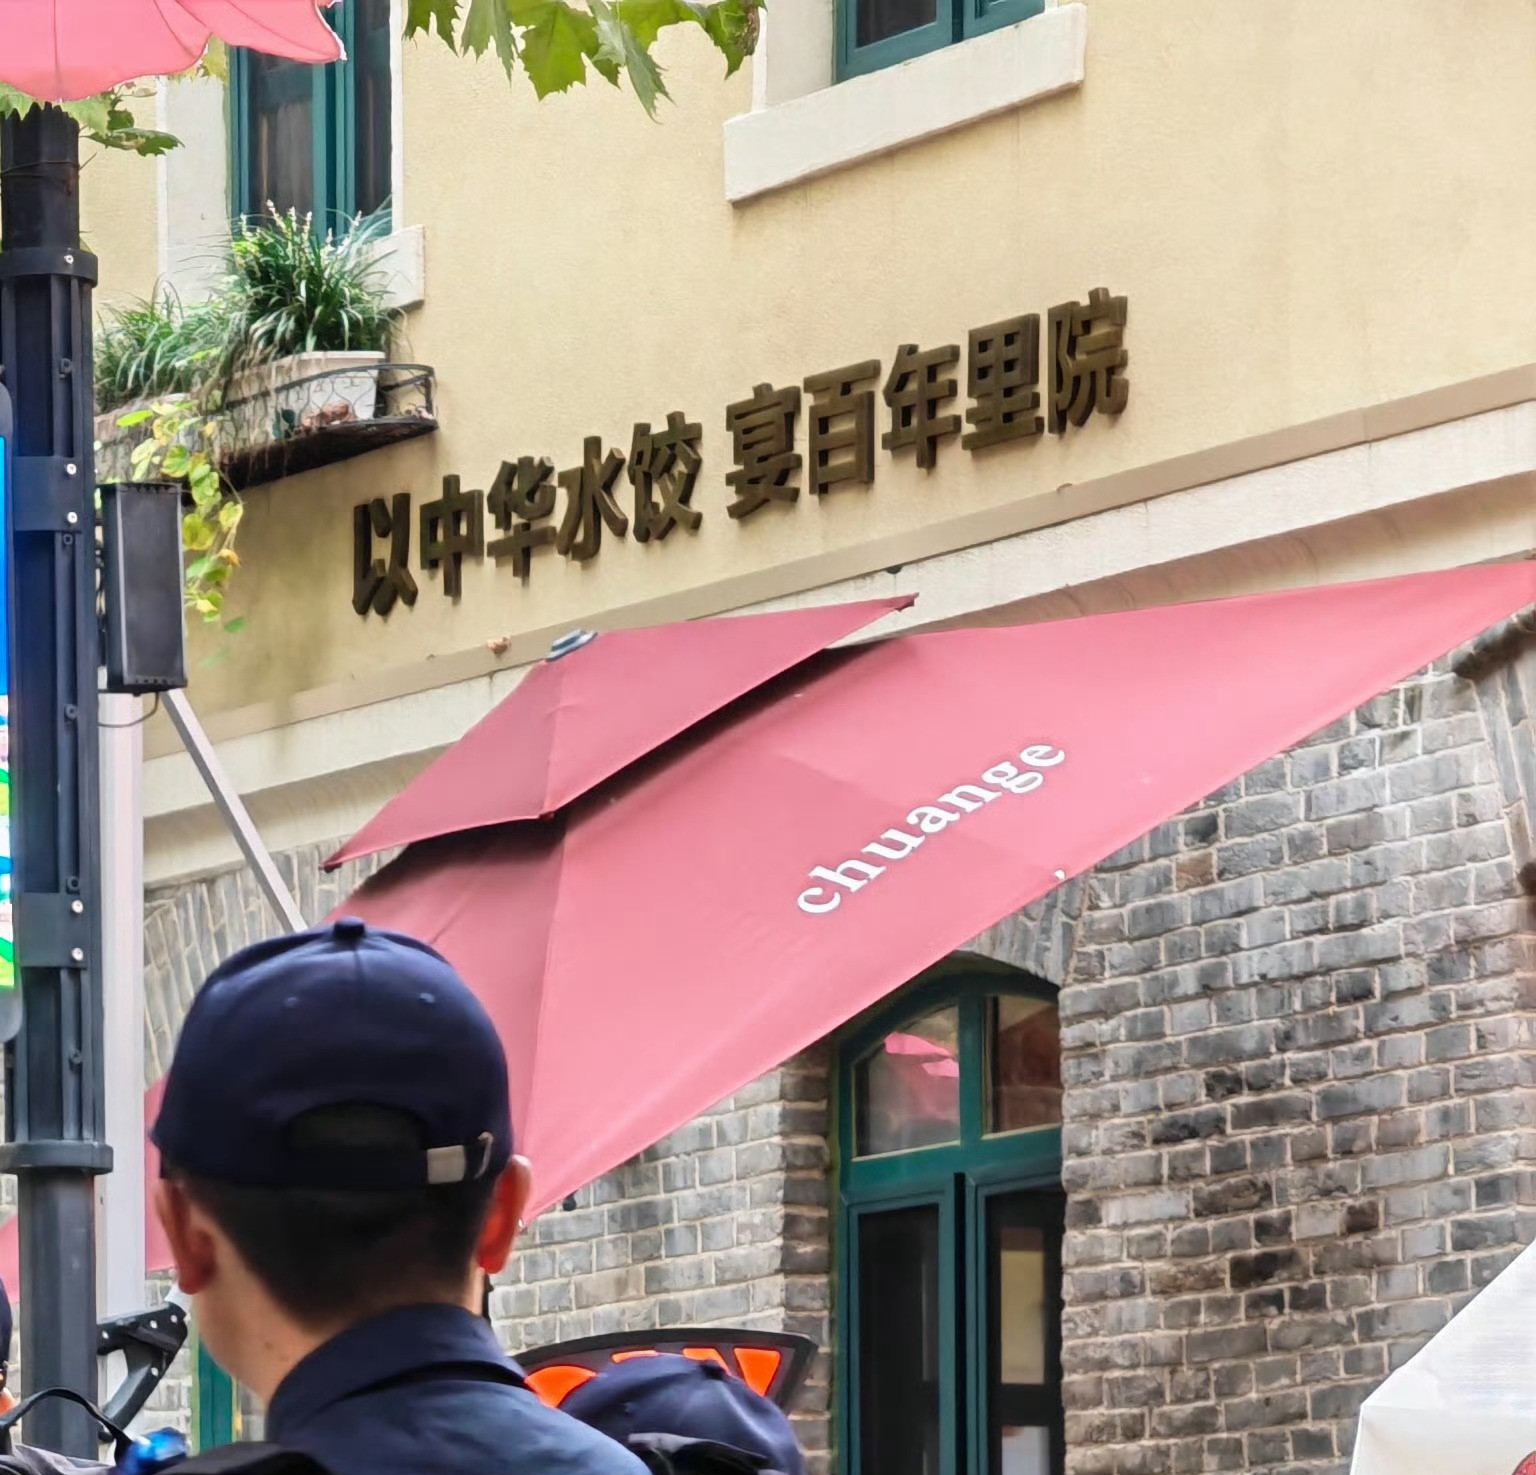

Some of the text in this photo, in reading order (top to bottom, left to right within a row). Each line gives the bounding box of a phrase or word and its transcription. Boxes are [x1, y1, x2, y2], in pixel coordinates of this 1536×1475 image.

[352, 286, 1130, 617] 以中华水饺 宴百年里院
[796, 744, 1066, 914] chuange
